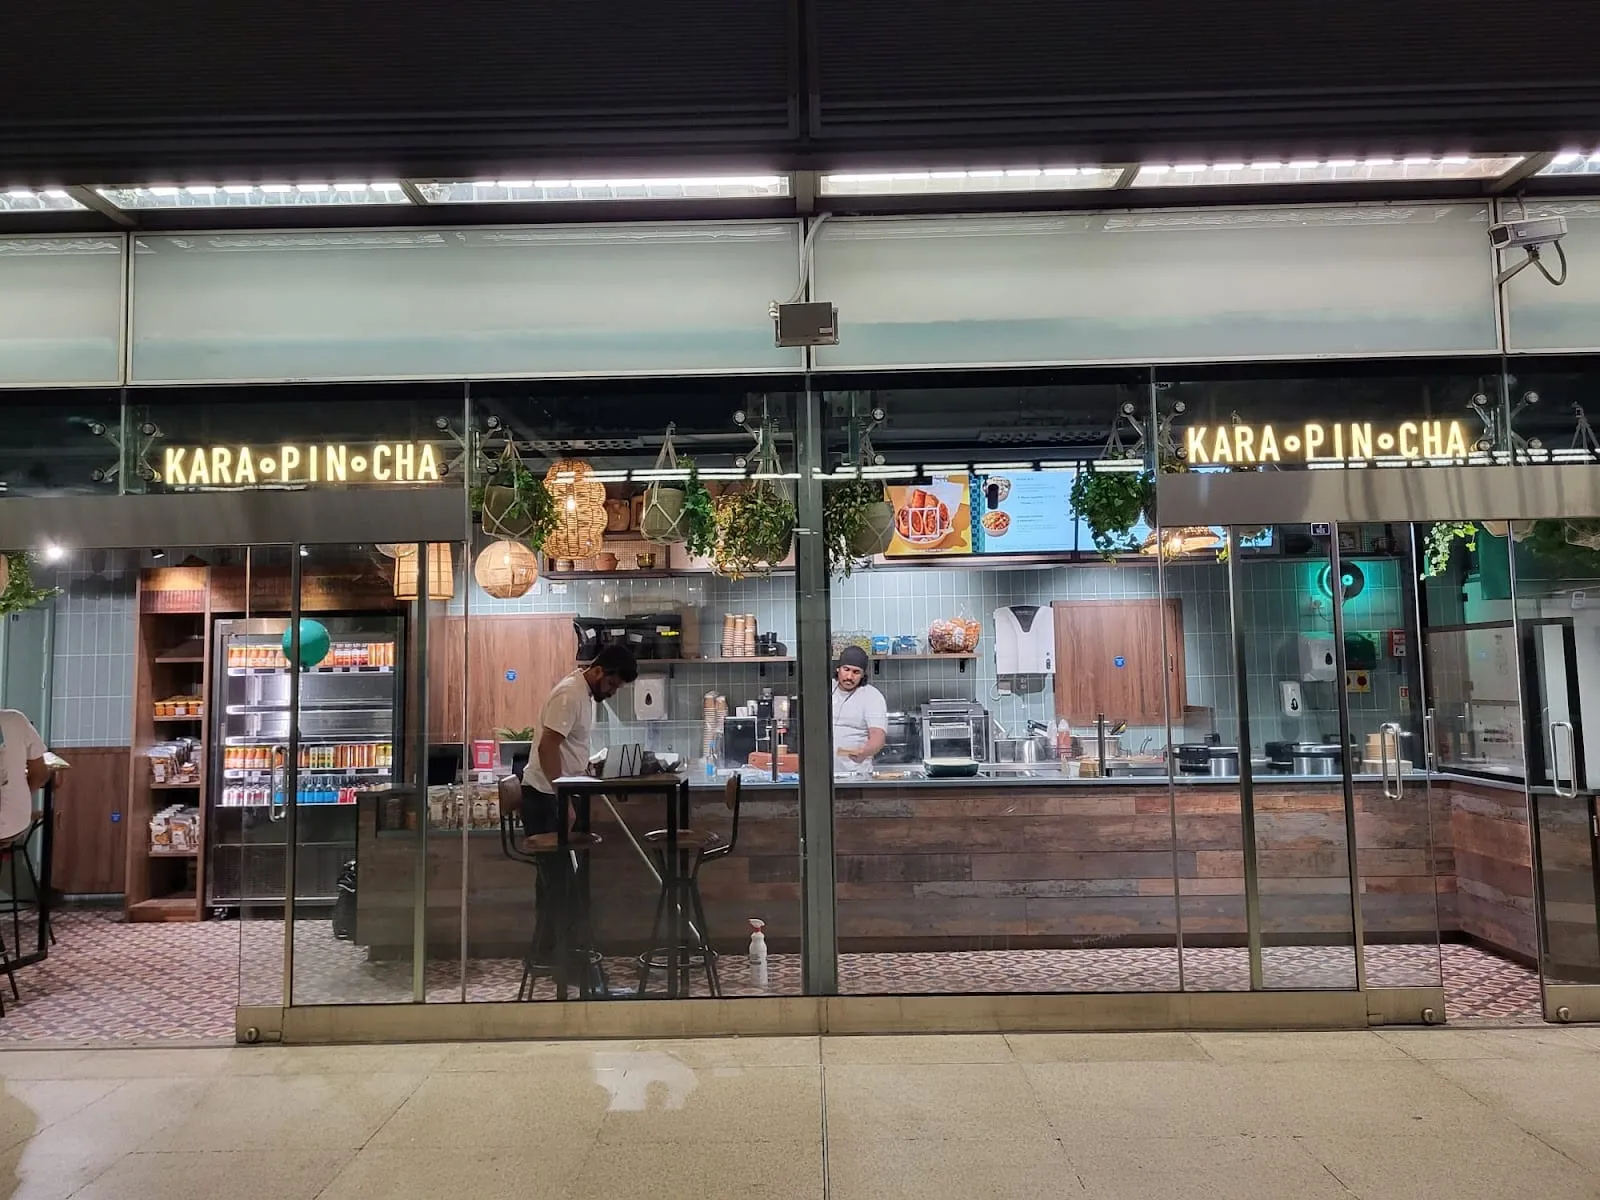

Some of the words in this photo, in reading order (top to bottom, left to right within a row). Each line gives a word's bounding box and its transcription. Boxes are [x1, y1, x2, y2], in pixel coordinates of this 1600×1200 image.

[1187, 423, 1281, 463] KARA
[1304, 422, 1373, 460] PIN
[1399, 420, 1467, 459] CHA
[165, 446, 257, 485] KARA
[281, 445, 347, 482] PIN
[373, 443, 439, 481] CHA
